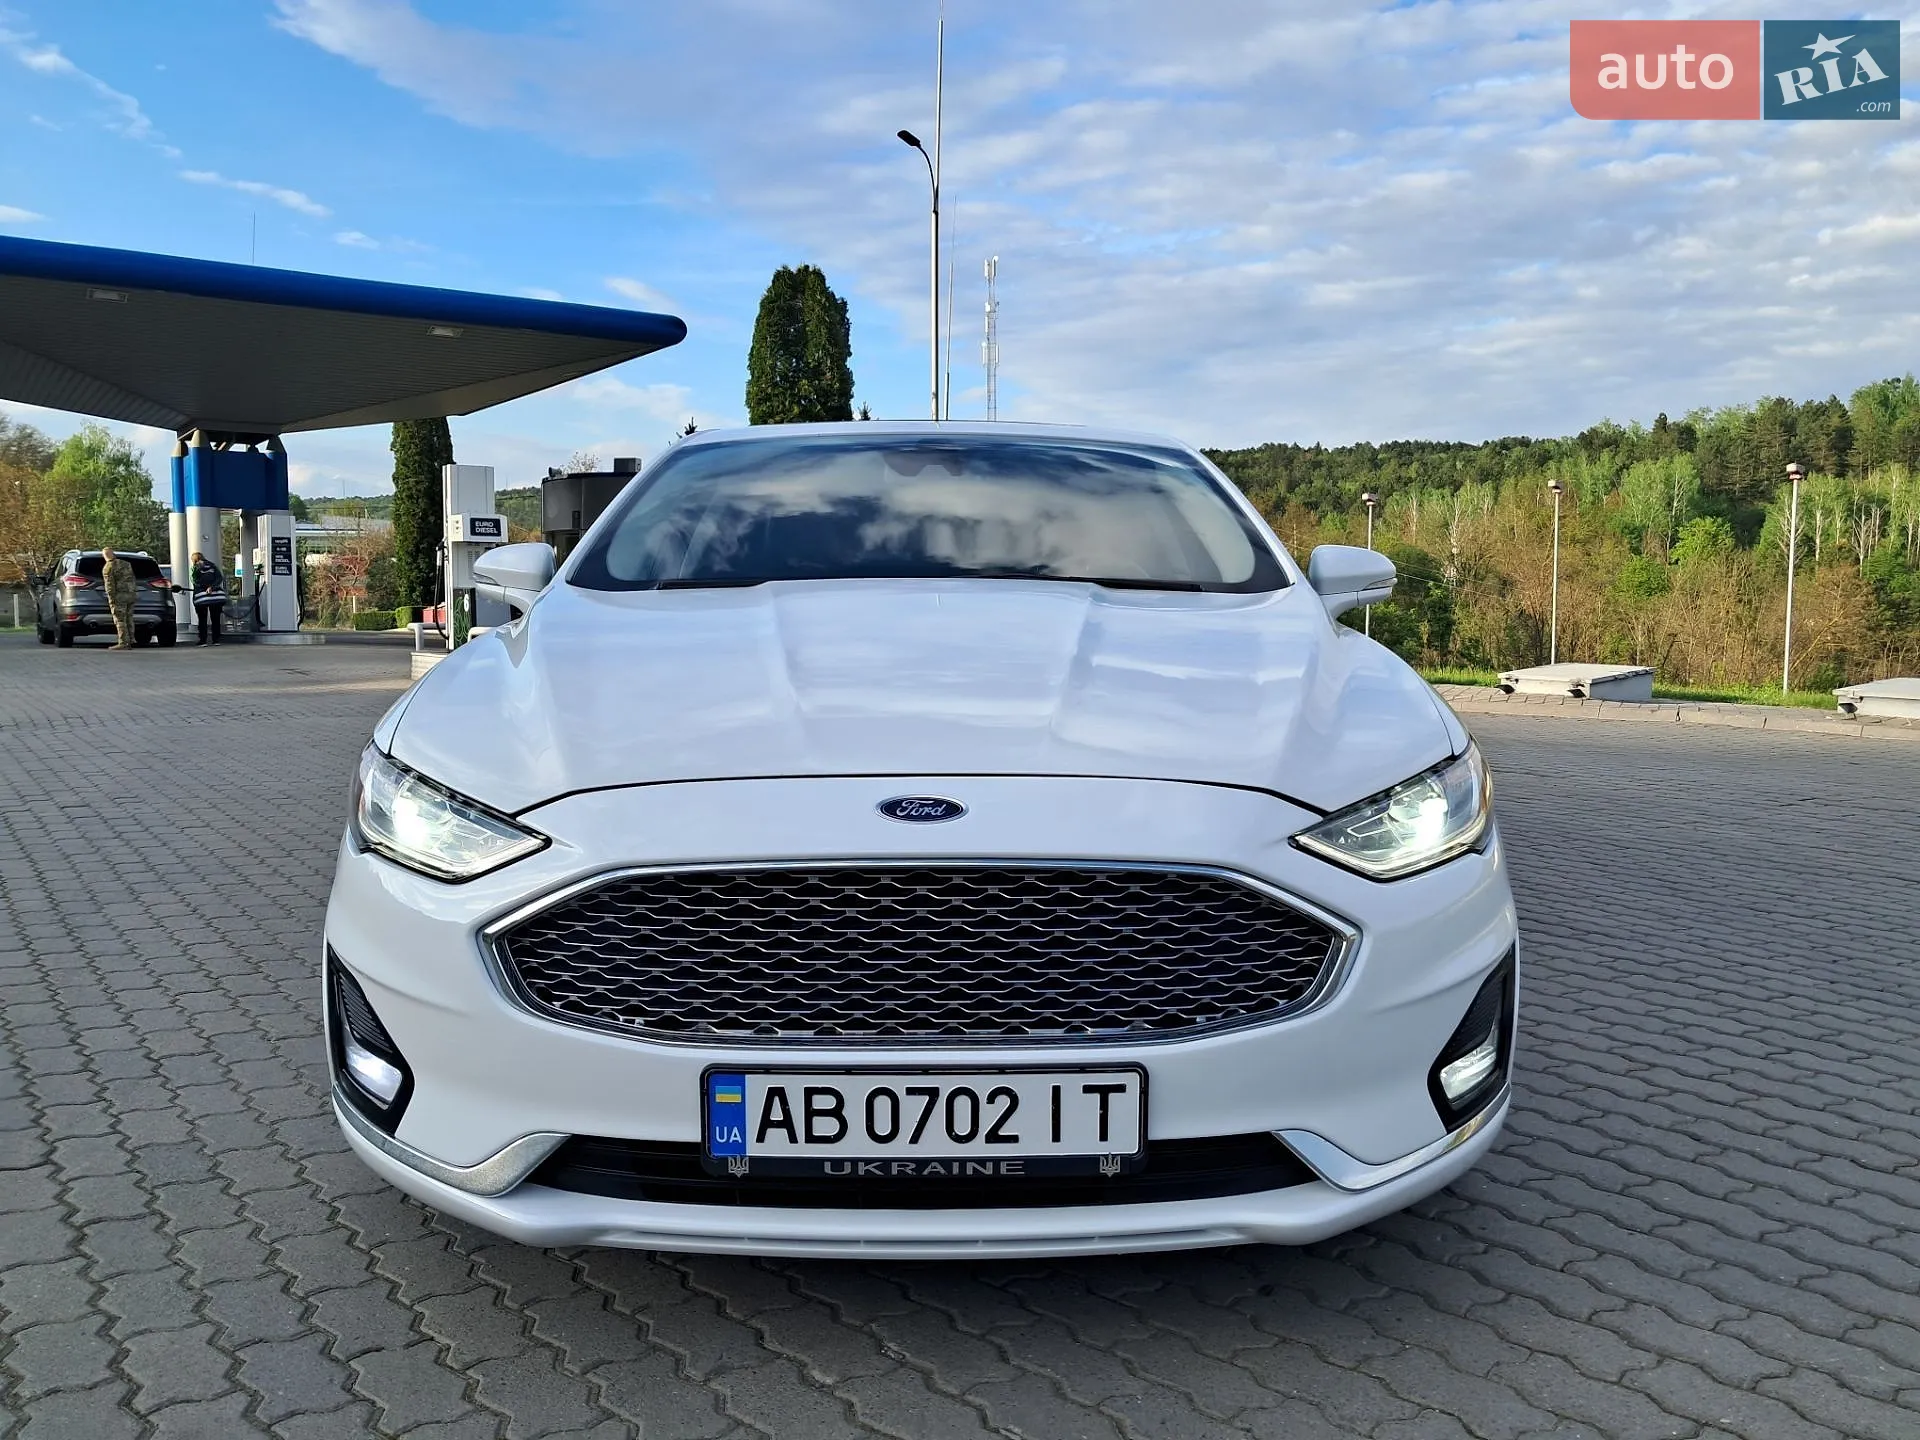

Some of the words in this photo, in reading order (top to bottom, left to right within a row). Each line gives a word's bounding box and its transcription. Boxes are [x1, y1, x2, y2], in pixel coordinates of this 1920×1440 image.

[463, 593, 470, 612] 6
[896, 799, 947, 816] Ford
[755, 1085, 849, 1145] AB
[864, 1085, 1020, 1145] 0702
[1050, 1083, 1127, 1144] IT
[715, 1126, 743, 1144] UA
[823, 1160, 1026, 1176] UKRAINE
